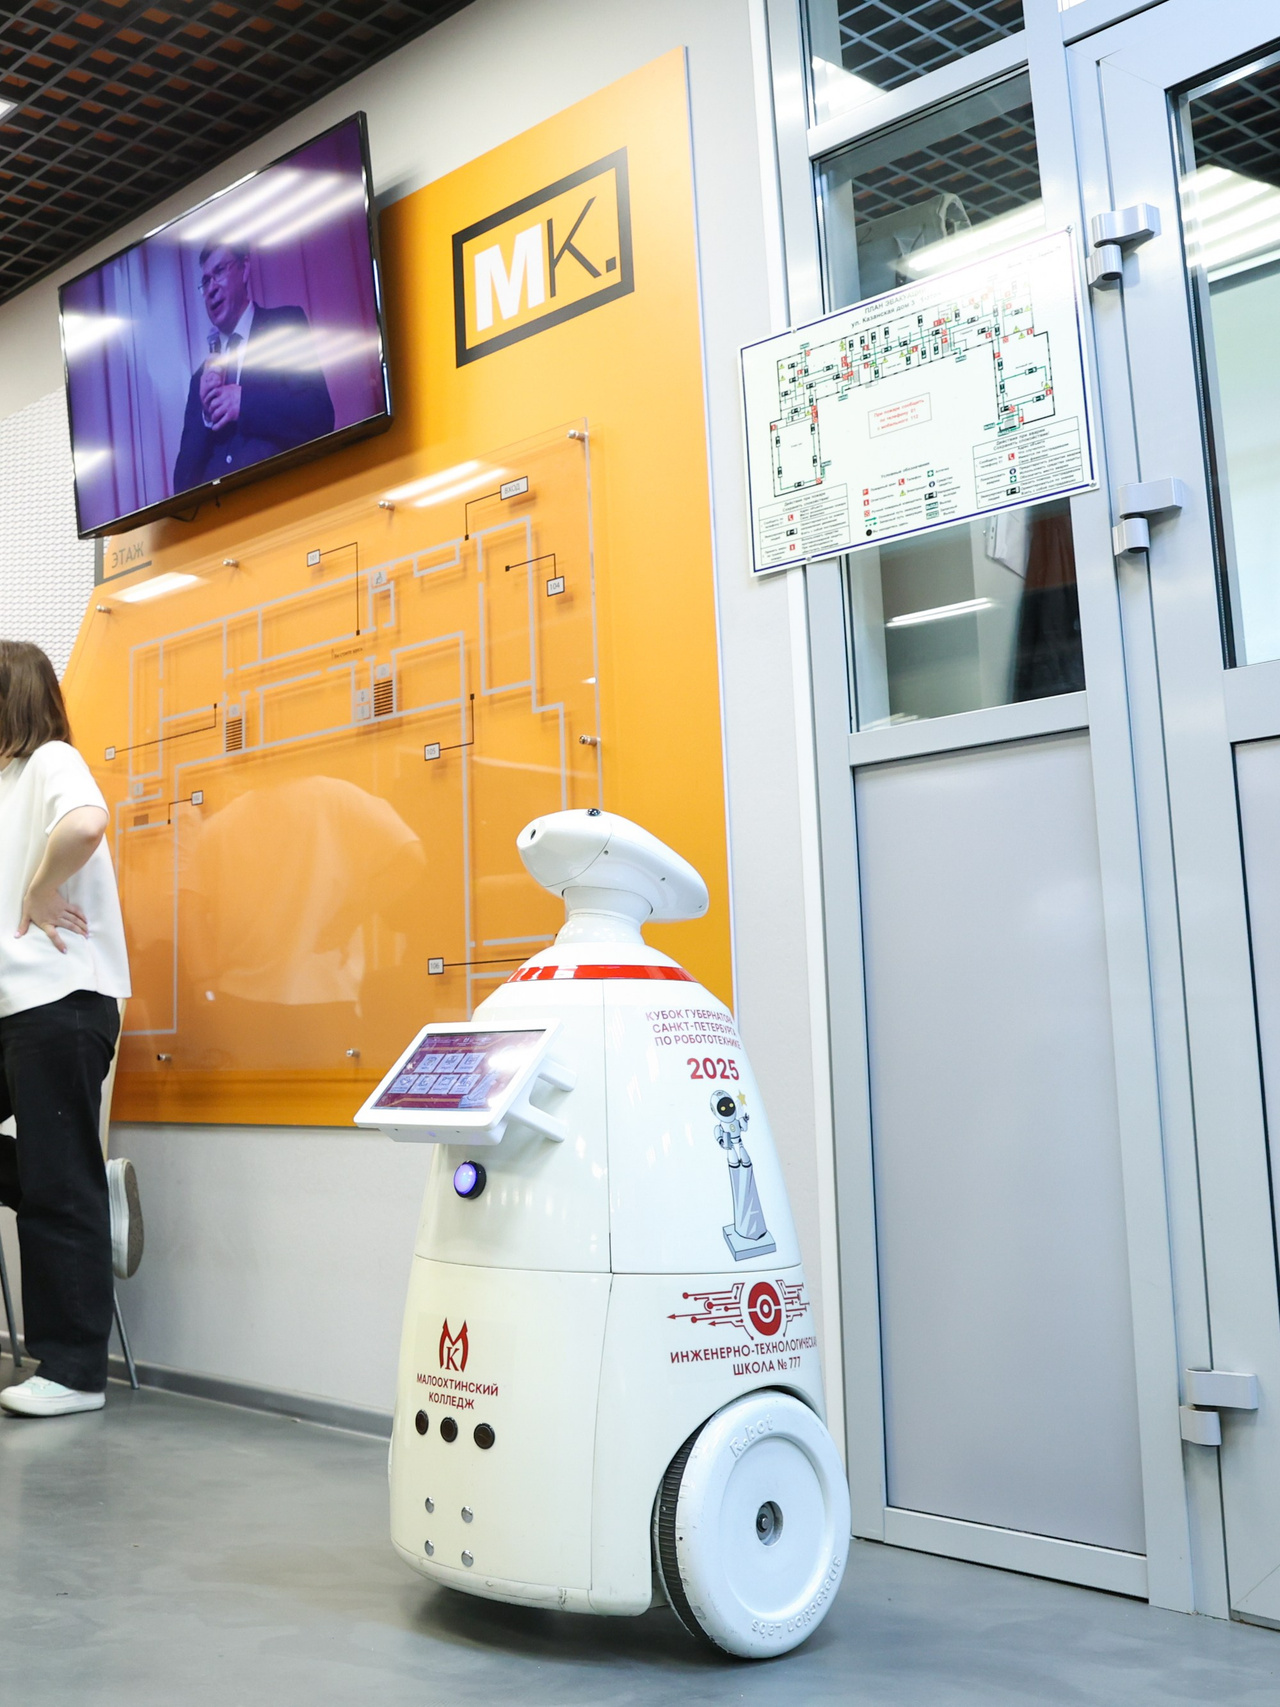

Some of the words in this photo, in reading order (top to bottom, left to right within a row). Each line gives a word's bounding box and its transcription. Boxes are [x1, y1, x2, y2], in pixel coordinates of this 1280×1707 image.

[111, 541, 144, 569] ЭТАЖ
[645, 1009, 684, 1021] КУБОК
[652, 1021, 737, 1037] САНКТ-ПЕТЕРБУРГА
[654, 1036, 672, 1046] ПО
[673, 1034, 741, 1050] РОБОТОТЕХНИКЕ
[686, 1057, 739, 1080] 2025
[733, 1359, 775, 1376] ШКОЛА
[788, 1355, 801, 1369] 777
[416, 1372, 499, 1397] МАЛООХТИНСКИЙ
[428, 1391, 475, 1410] КОЛЛЕДЖ
